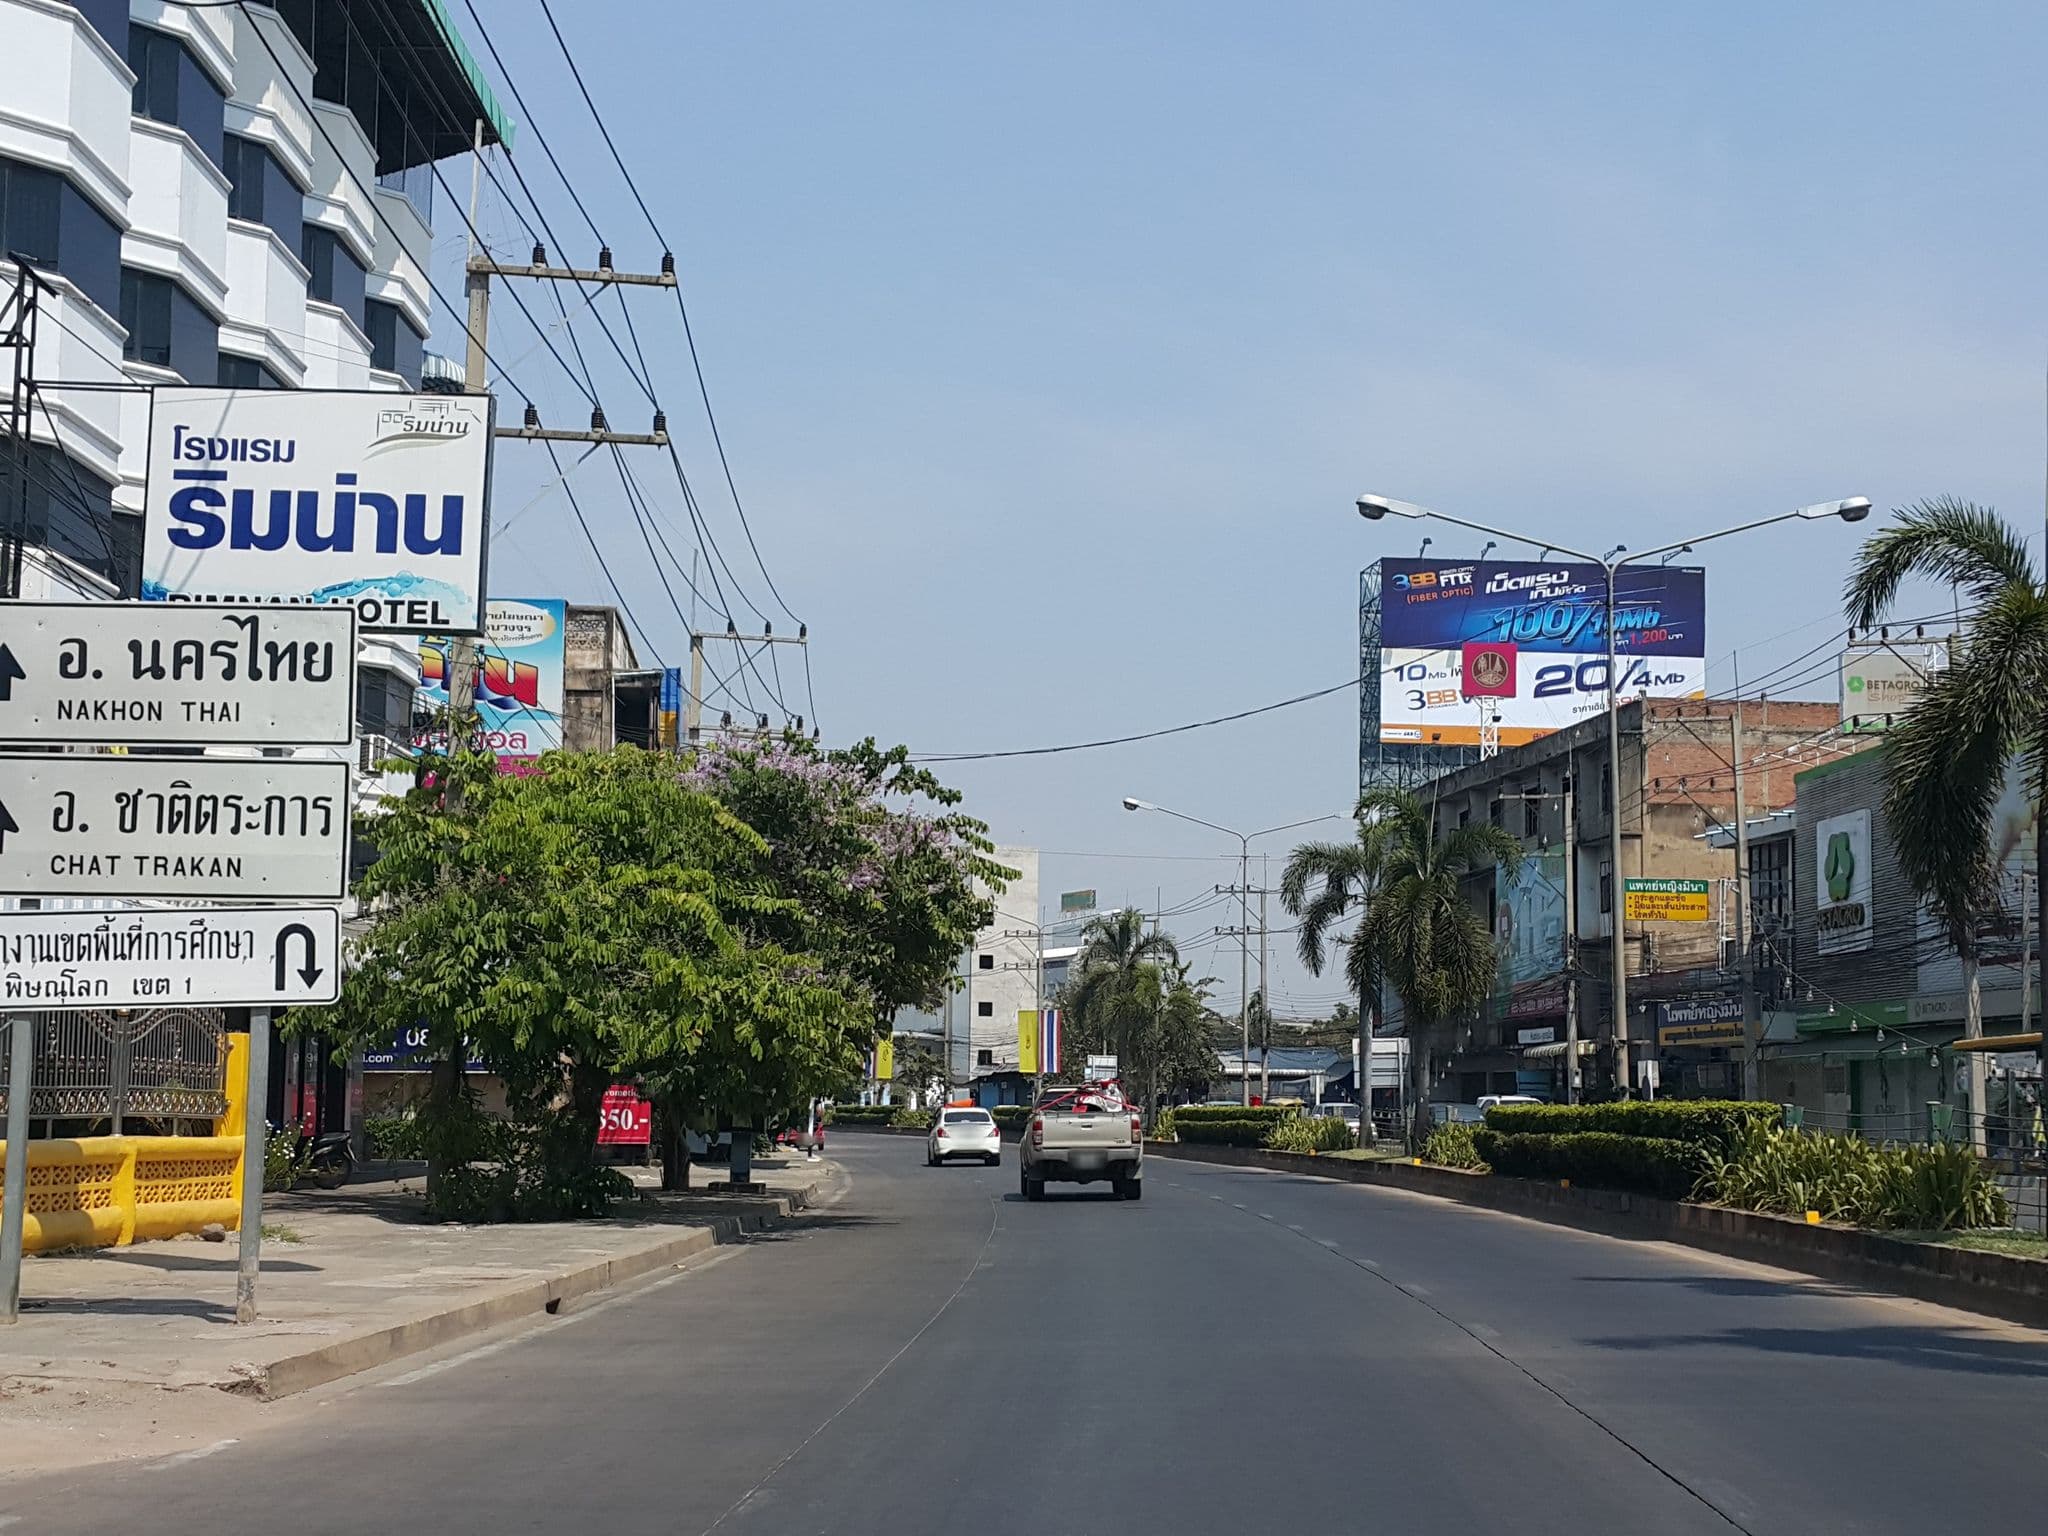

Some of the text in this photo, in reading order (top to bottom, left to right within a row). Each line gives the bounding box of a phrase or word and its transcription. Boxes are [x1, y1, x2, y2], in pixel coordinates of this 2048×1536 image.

[403, 414, 469, 433] ริมน่าน
[173, 424, 296, 463] โรงแรม
[167, 469, 465, 556] ริมน่าน
[1407, 585, 1474, 604] (FIBER OPTIC)
[59, 614, 334, 683] อ. นครไทย
[1866, 680, 1919, 690] BETAGRO
[57, 700, 240, 722] NAKHON THAI
[1405, 689, 1458, 711] 3BB
[52, 780, 332, 837] อ. ชาติตระการ
[51, 855, 242, 877] CHAT TRAKAN
[5, 968, 192, 1004] พิษณุโลก เขต 1
